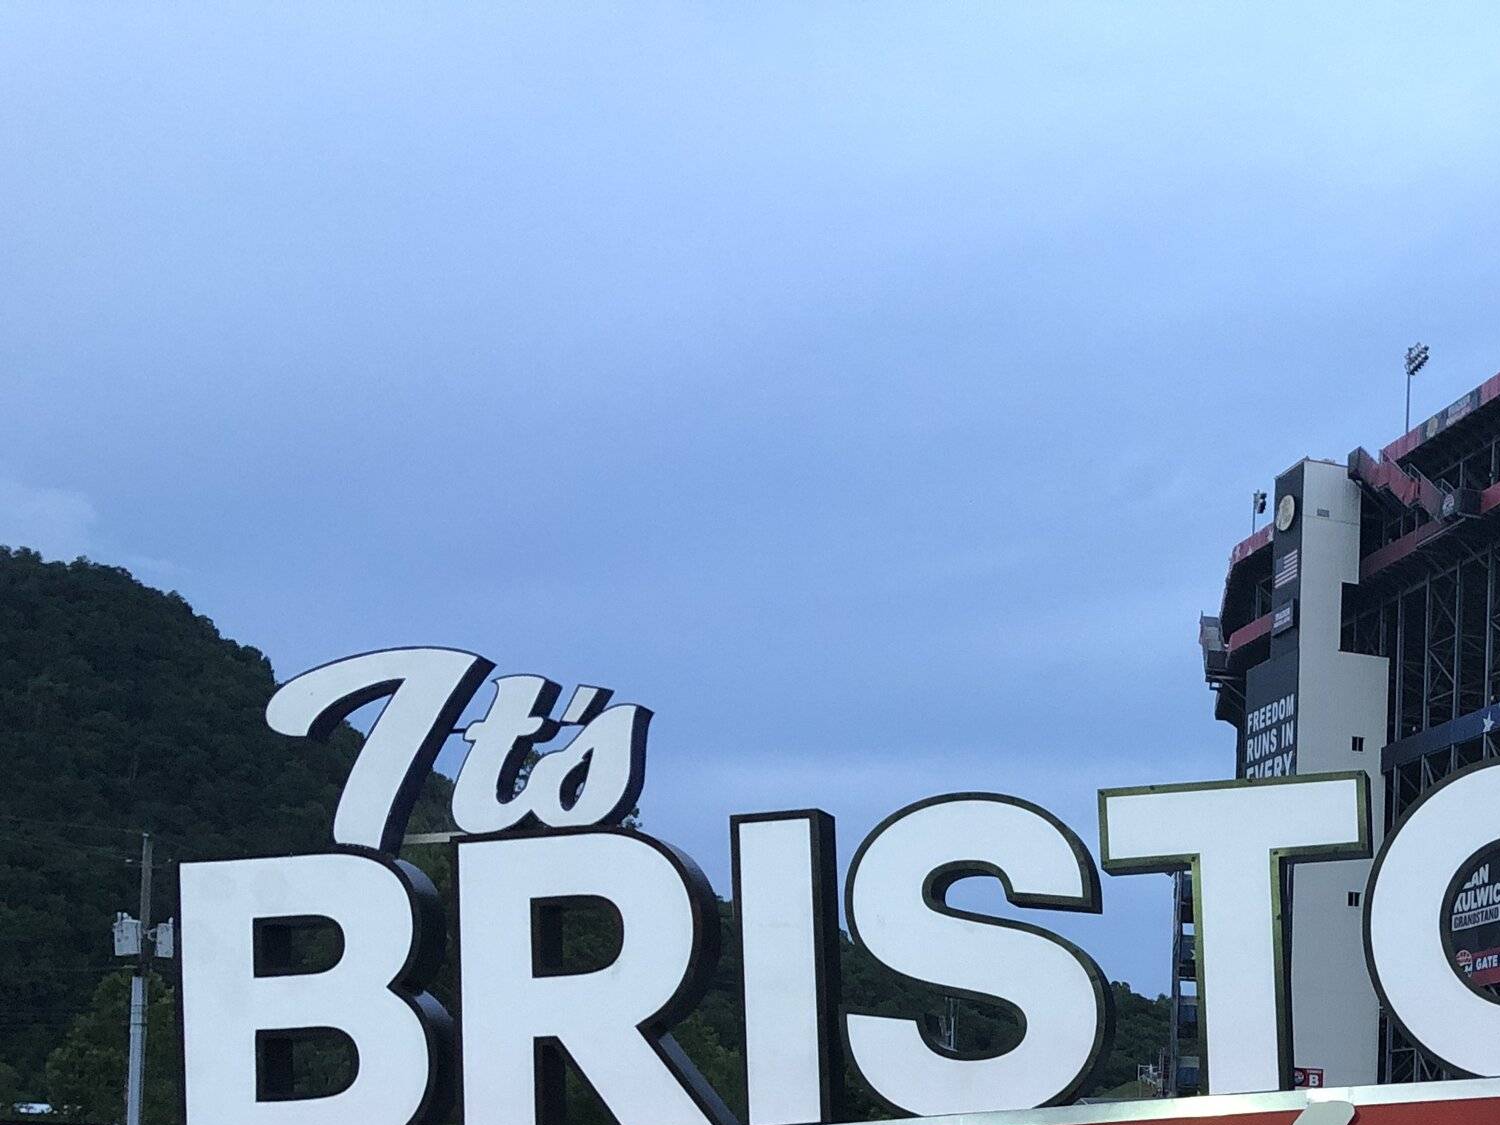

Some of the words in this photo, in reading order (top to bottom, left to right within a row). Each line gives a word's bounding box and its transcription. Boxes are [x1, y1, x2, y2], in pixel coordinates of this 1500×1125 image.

[1247, 693, 1295, 735] FREEDOM
[265, 645, 655, 850] It's
[1246, 727, 1278, 764] RUNS
[1281, 719, 1294, 750] IN
[1475, 954, 1499, 971] GATE
[1308, 1074, 1320, 1087] B
